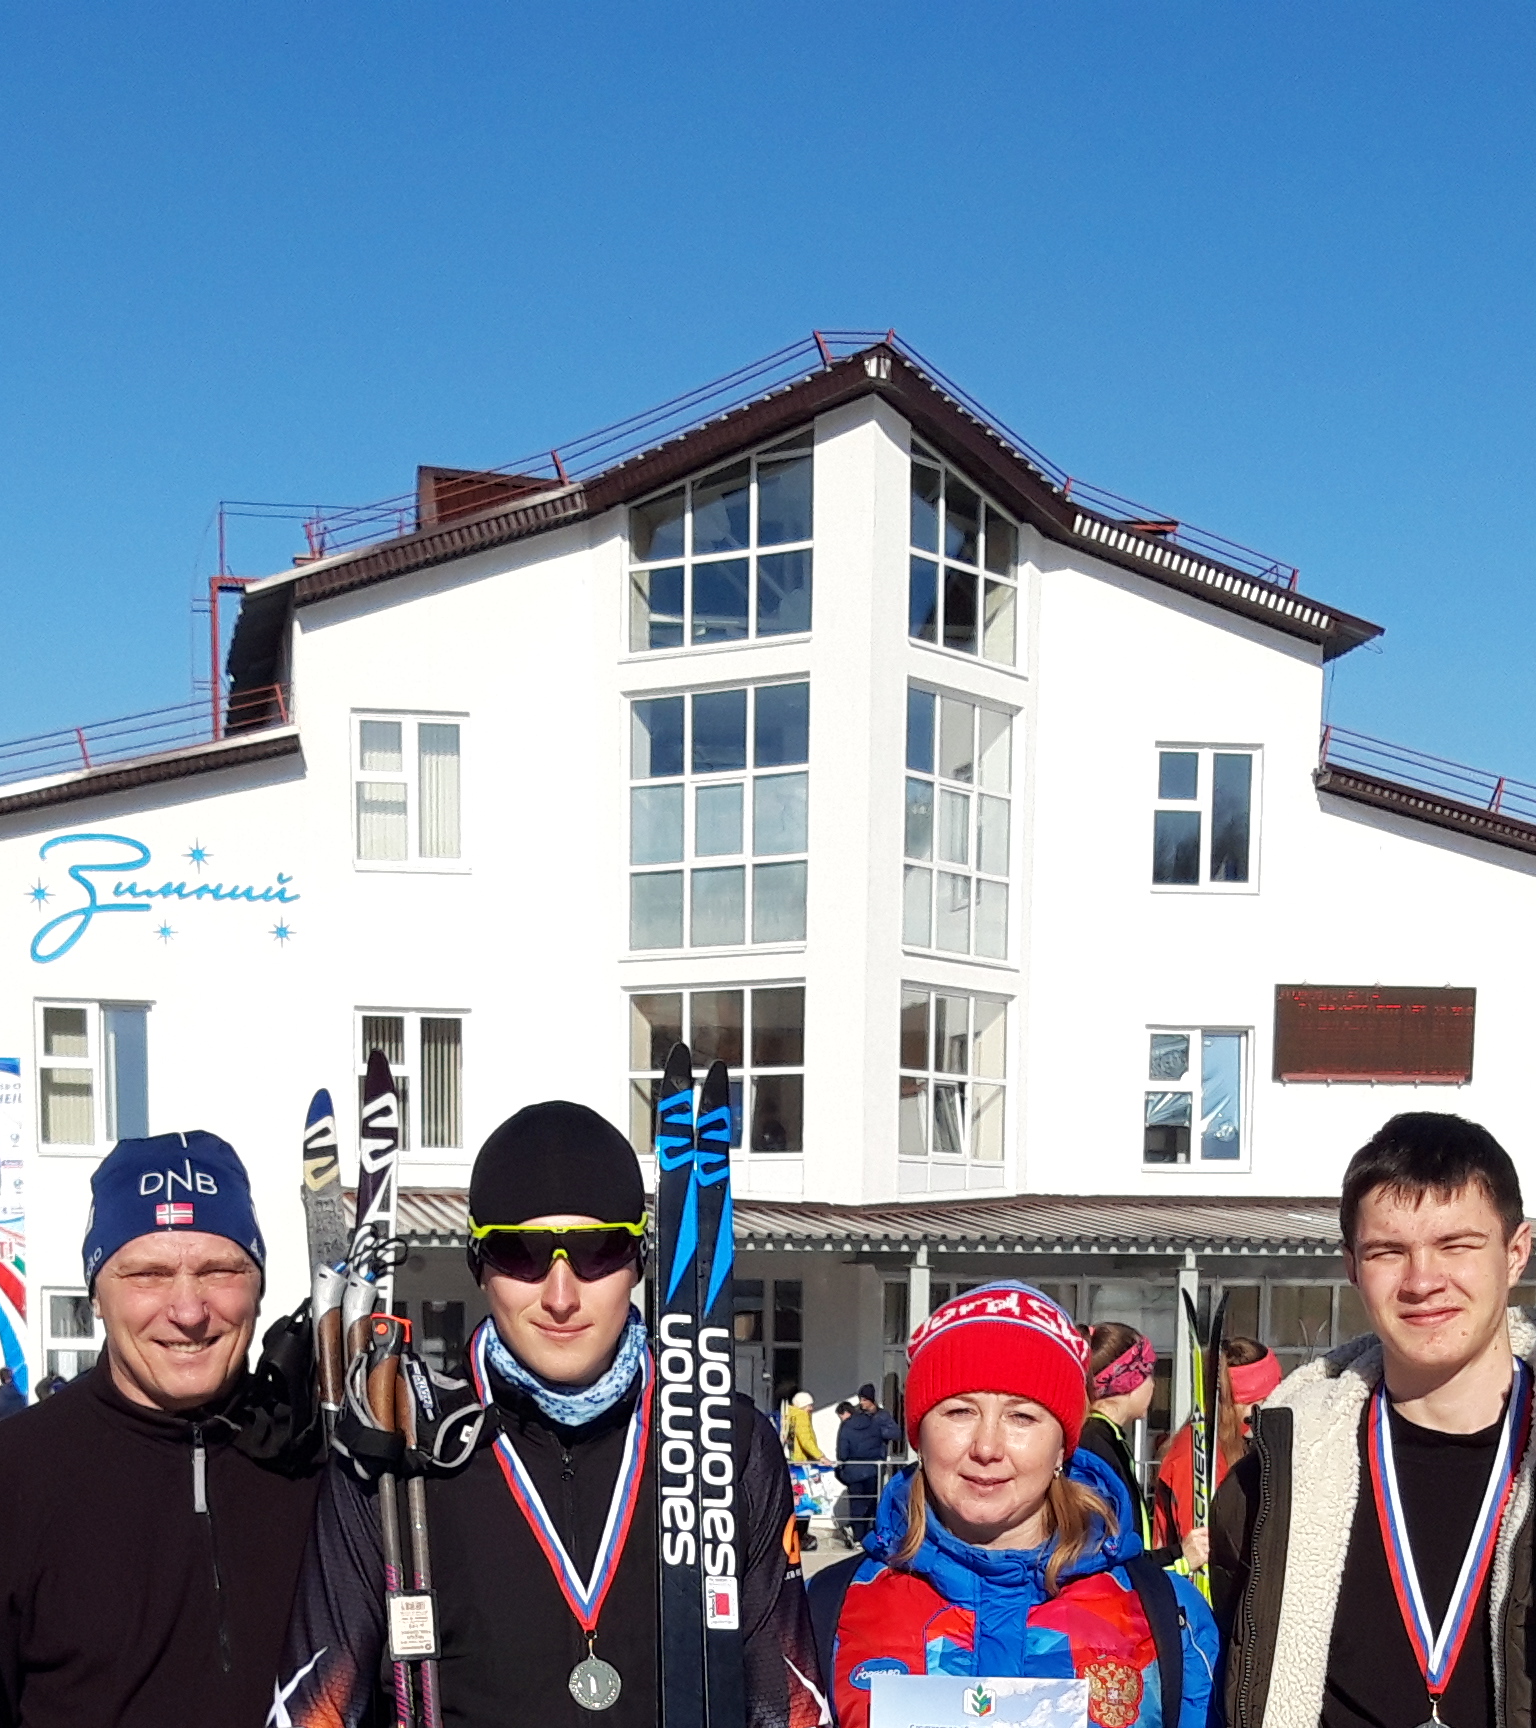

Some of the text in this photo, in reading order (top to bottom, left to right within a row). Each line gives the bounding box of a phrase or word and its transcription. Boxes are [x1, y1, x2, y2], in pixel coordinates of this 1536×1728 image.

[30, 833, 300, 963] Зимний
[140, 1158, 218, 1201] DNB
[659, 1312, 695, 1567] salomon
[697, 1325, 737, 1577] salomon
[1194, 1429, 1207, 1528] CHER
